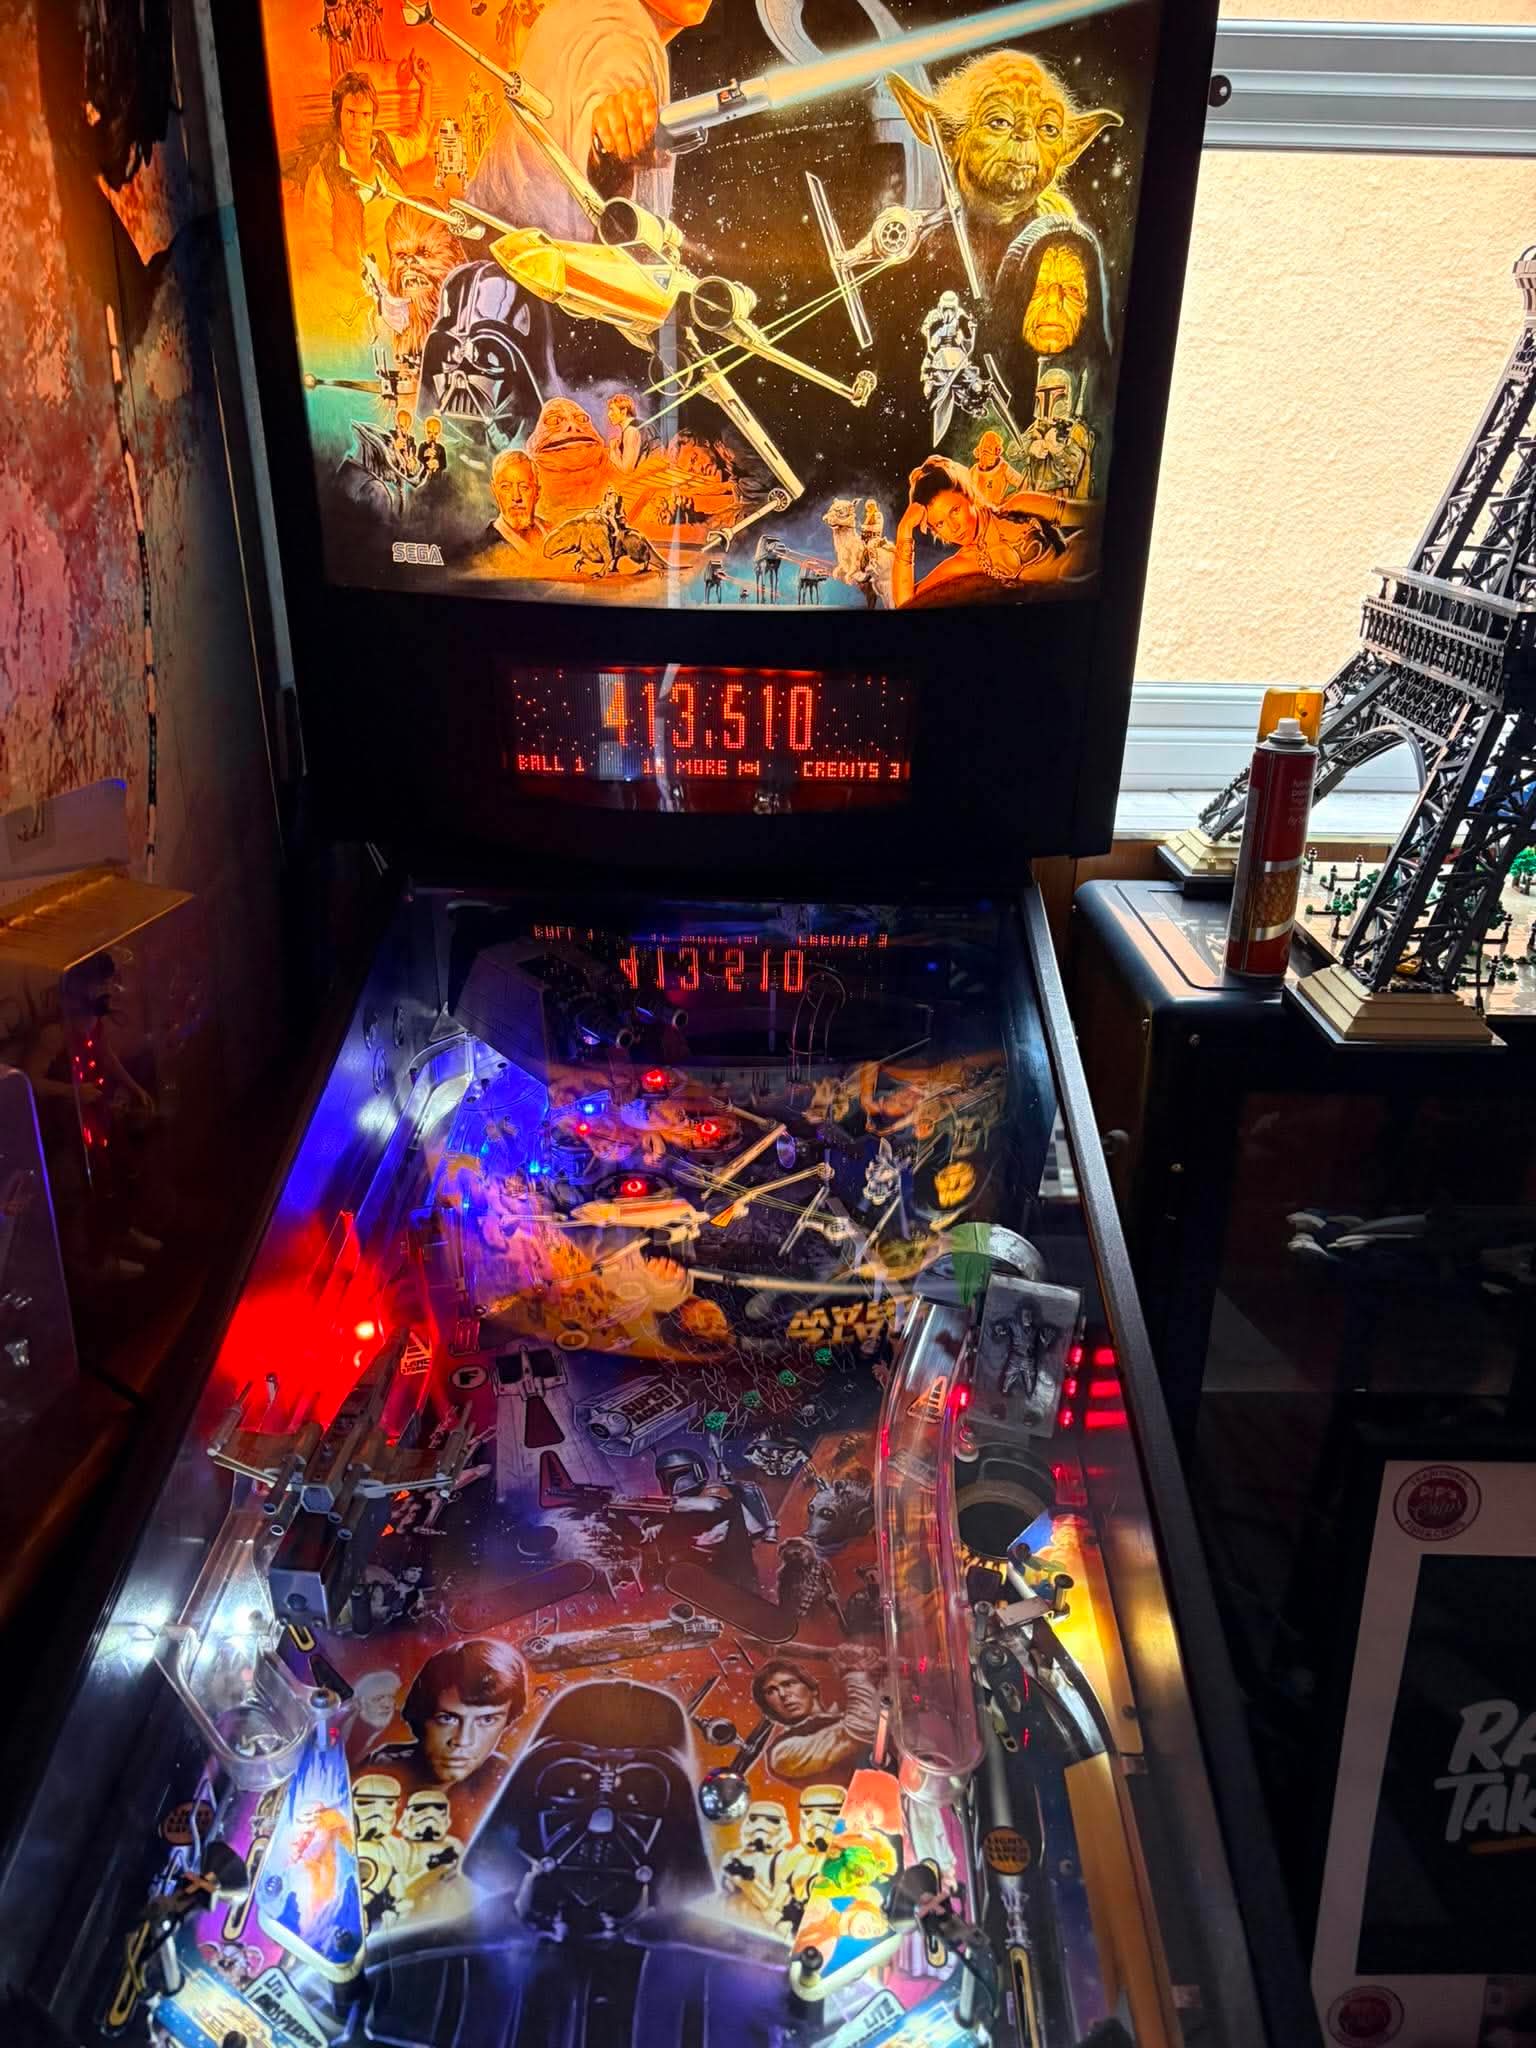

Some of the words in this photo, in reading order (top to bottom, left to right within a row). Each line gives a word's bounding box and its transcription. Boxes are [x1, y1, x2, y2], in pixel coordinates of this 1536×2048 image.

[392, 541, 445, 566] SEGA
[603, 681, 813, 751] 413,510
[518, 754, 564, 772] BALL
[573, 756, 585, 772] 1
[676, 758, 727, 776] MORE
[803, 761, 879, 778] CREDITS
[889, 764, 900, 779] 3
[621, 1385, 670, 1416] SUPER
[863, 1997, 897, 2030] LITE
